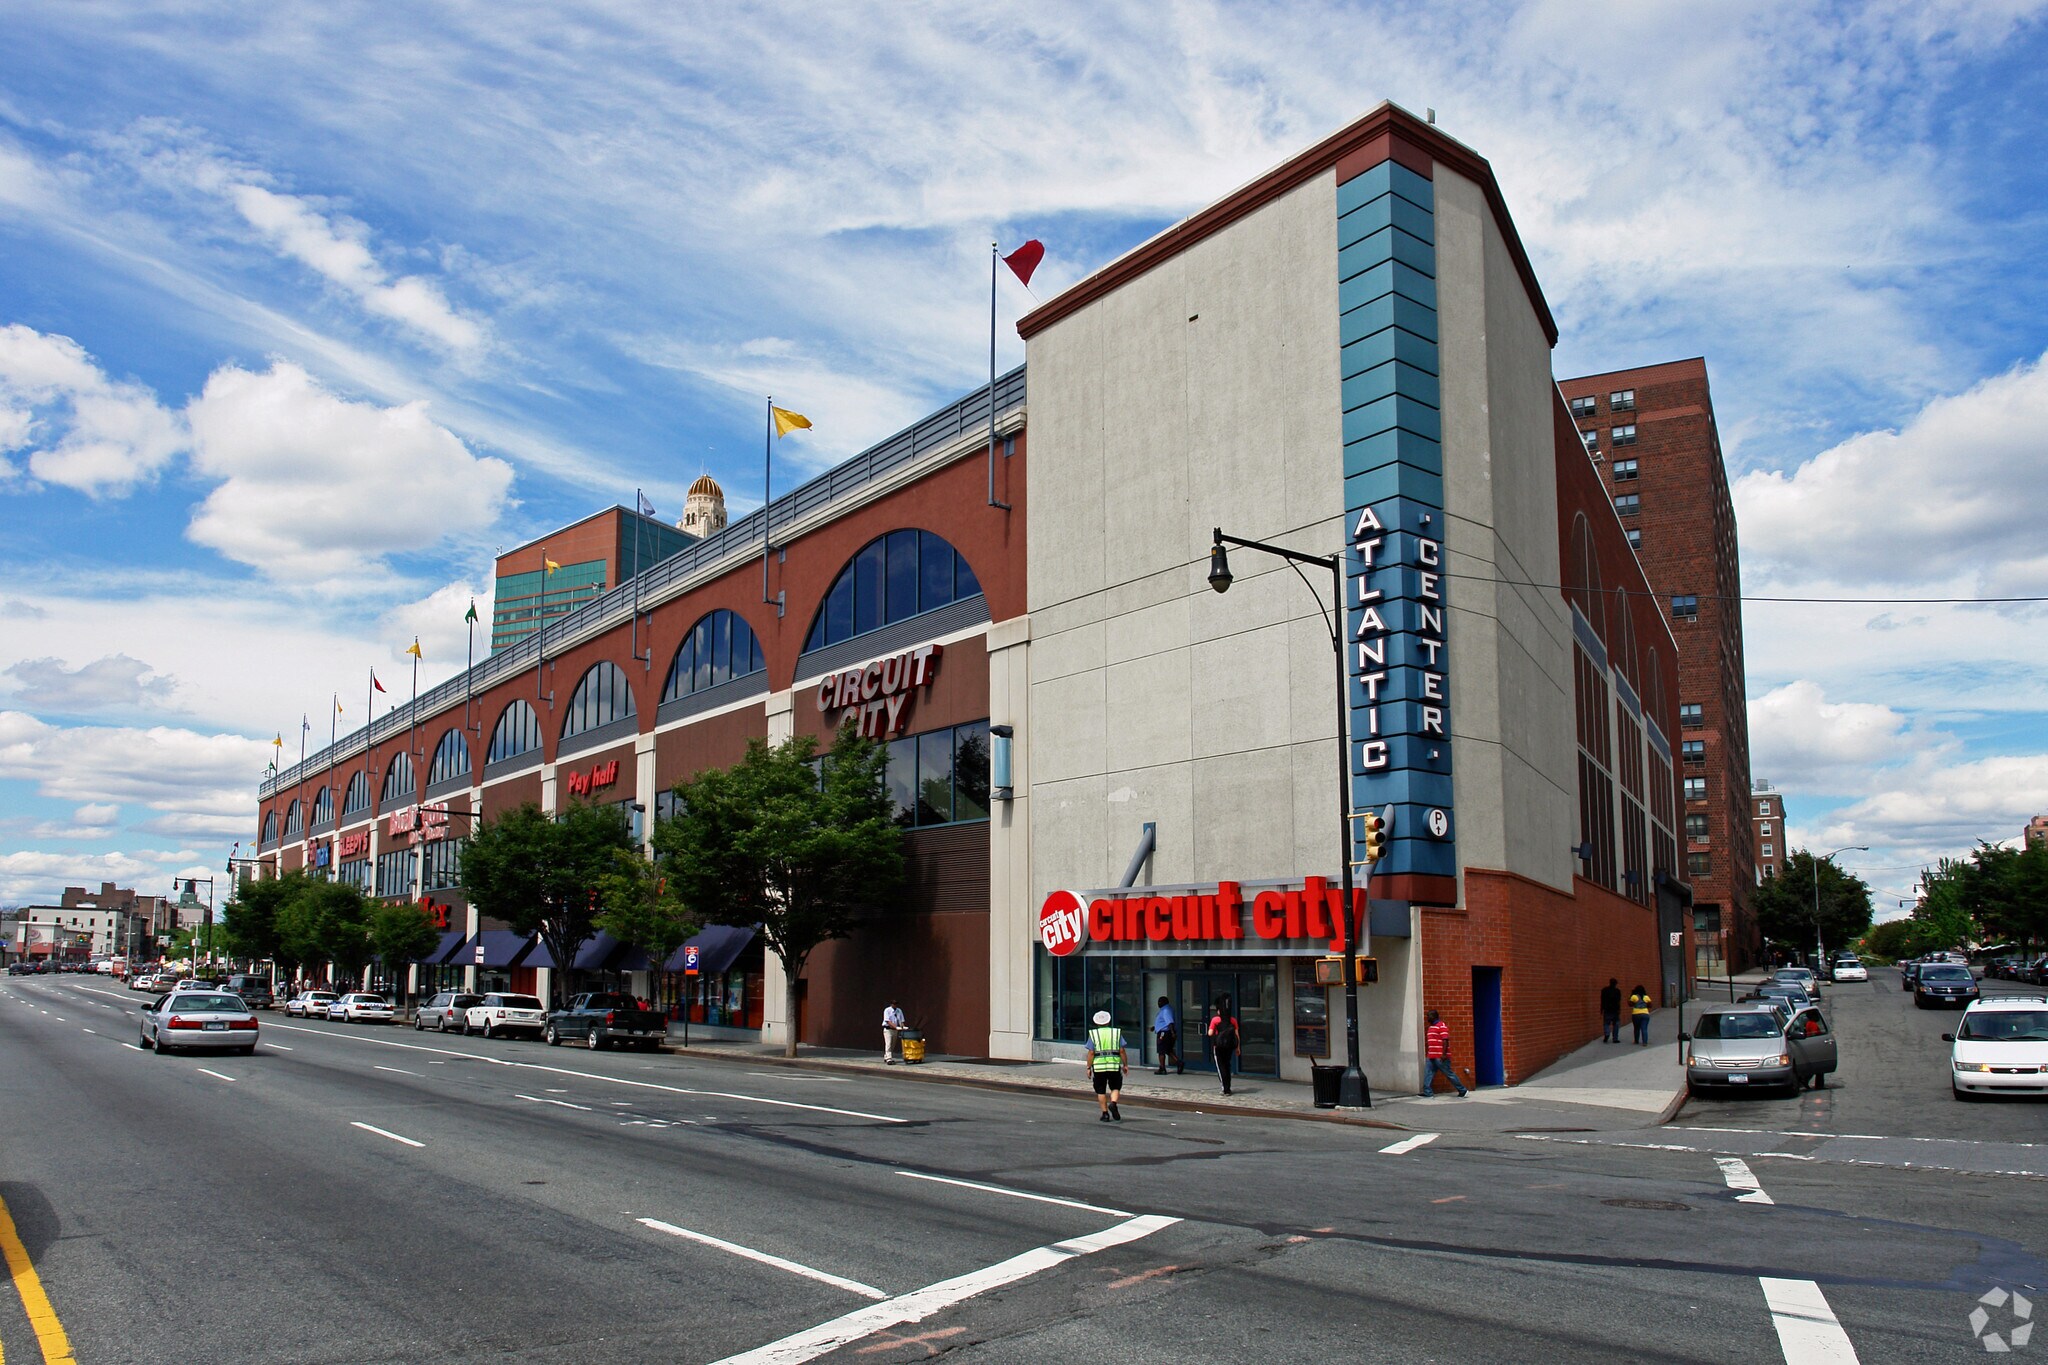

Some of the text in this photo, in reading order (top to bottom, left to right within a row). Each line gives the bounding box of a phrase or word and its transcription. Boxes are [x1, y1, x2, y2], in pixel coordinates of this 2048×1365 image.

[1353, 507, 1387, 769] ATLANTIC
[1419, 538, 1443, 734] CENTER
[817, 645, 942, 712] CIRCUIT
[840, 692, 908, 738] CITY
[1434, 811, 1443, 825] P
[1040, 909, 1061, 928] circuit
[1042, 907, 1081, 949] city
[1088, 876, 1366, 952] circuit city
